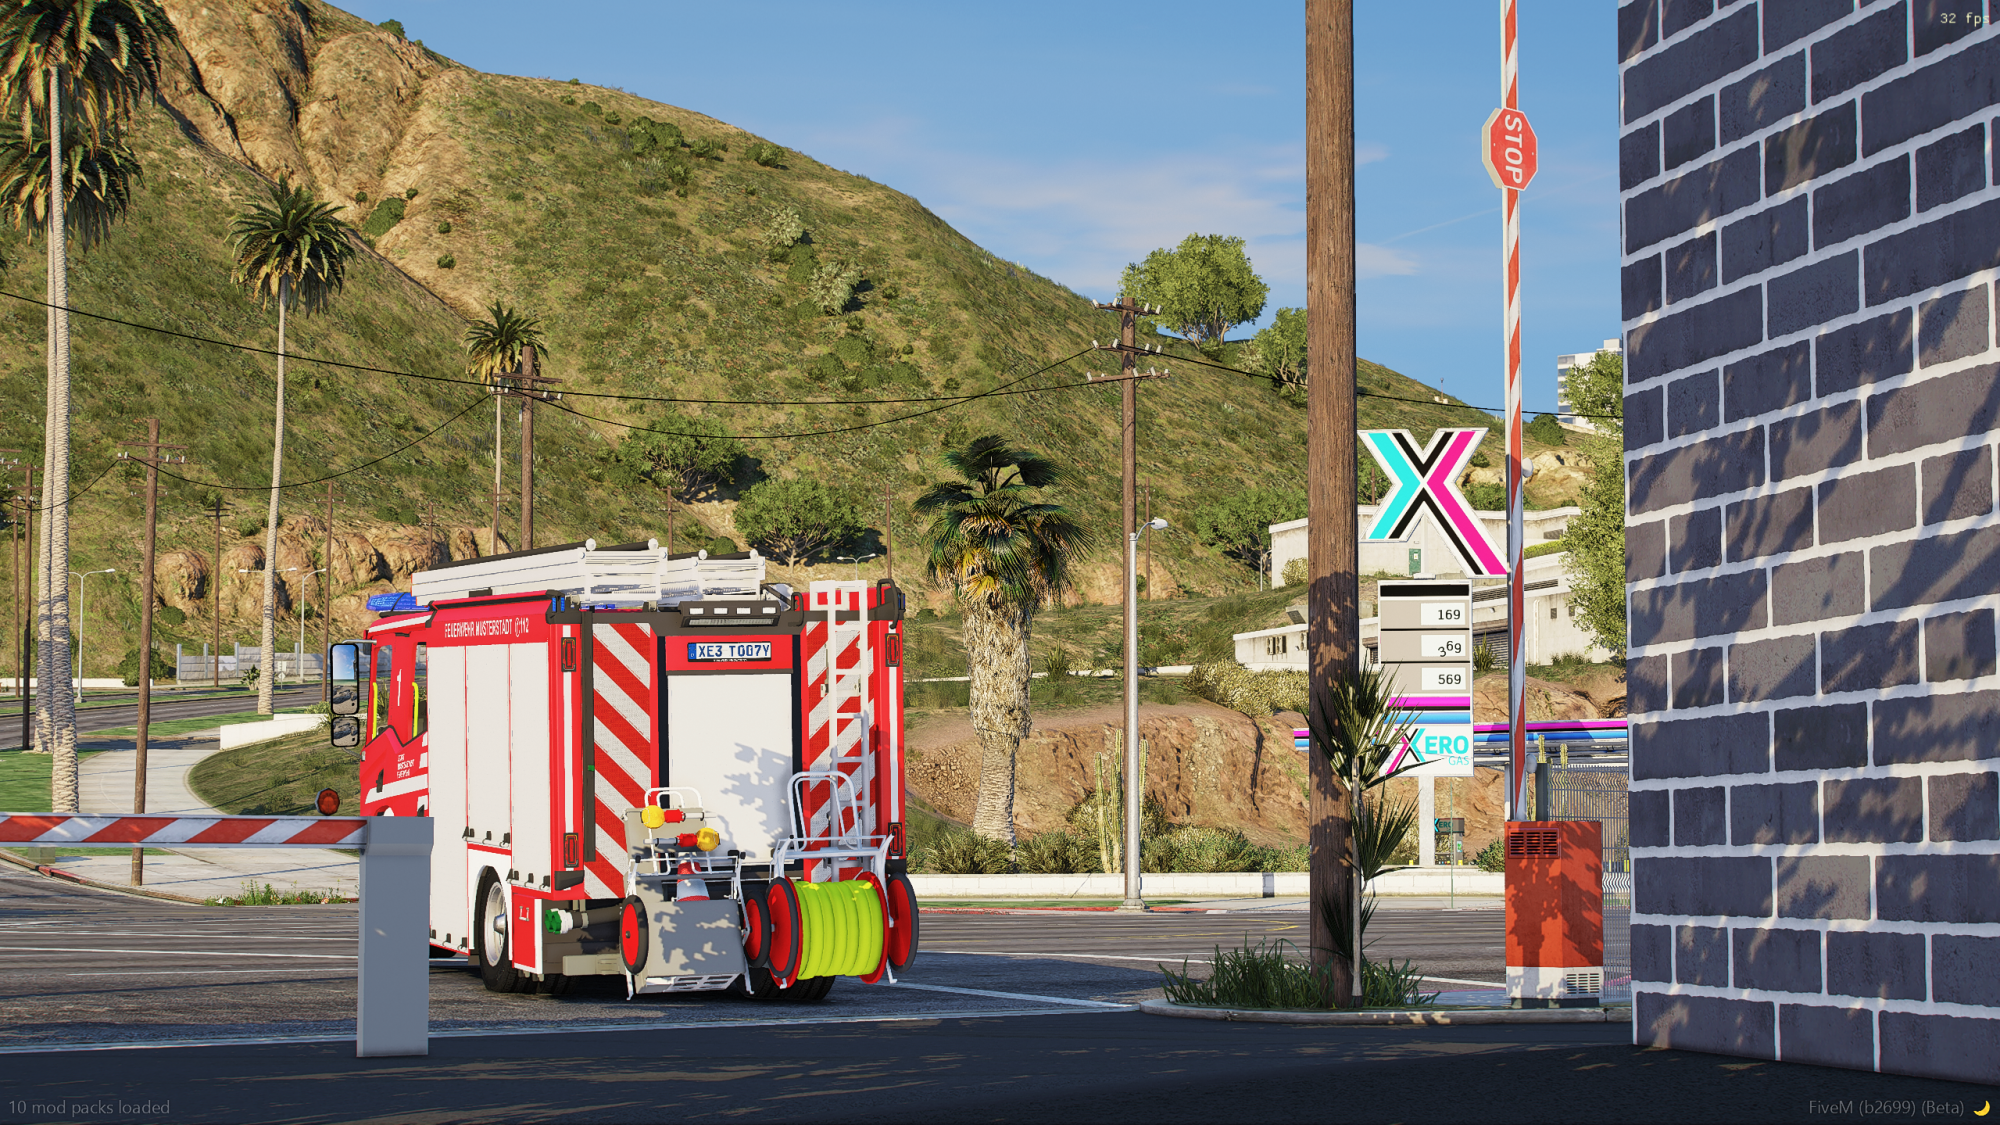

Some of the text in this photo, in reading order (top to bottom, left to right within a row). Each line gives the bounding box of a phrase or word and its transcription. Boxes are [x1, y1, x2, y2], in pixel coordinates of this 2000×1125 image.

[1504, 114, 1523, 184] STOP
[1437, 609, 1461, 621] 169
[698, 644, 723, 658] XE3
[1437, 640, 1462, 658] 369
[1437, 673, 1462, 685] 569
[1386, 728, 1470, 775] XERO
[1448, 755, 1470, 766] GAS
